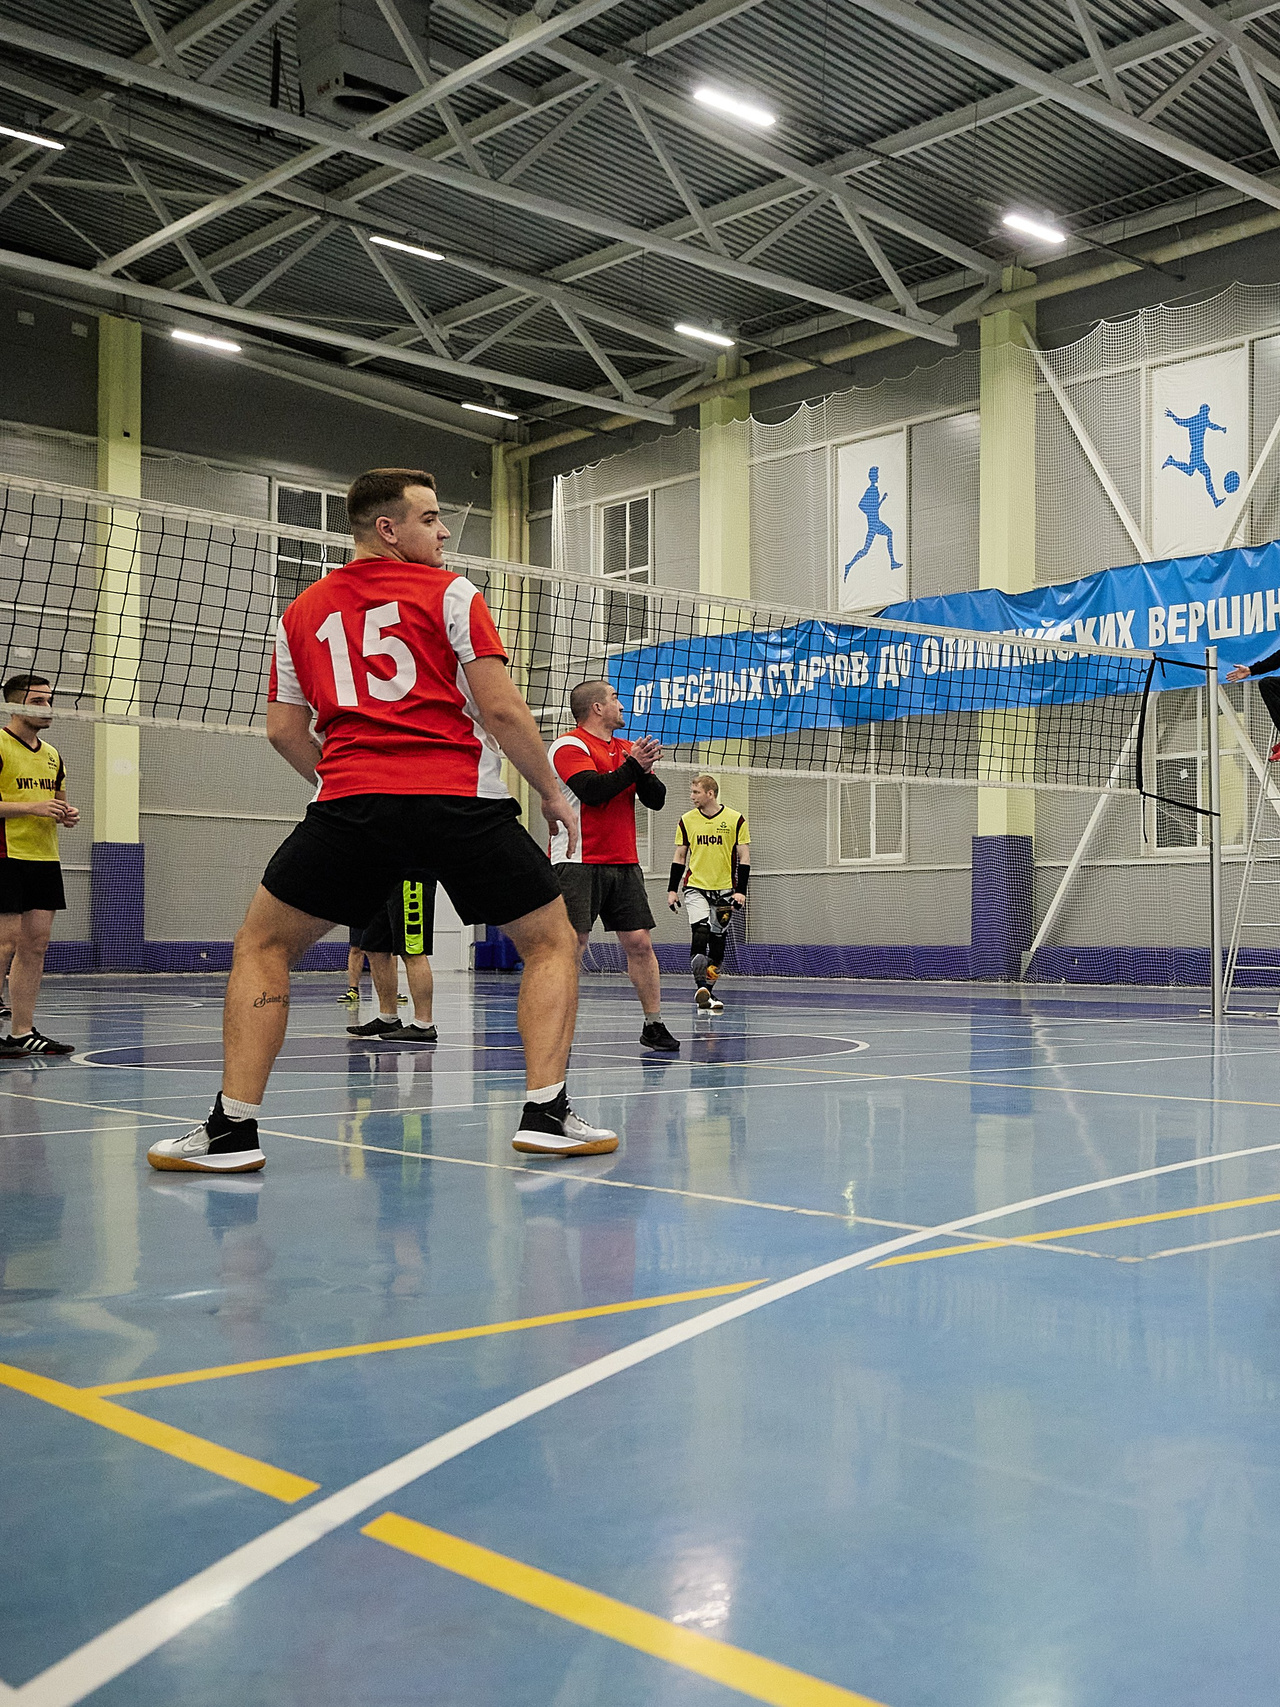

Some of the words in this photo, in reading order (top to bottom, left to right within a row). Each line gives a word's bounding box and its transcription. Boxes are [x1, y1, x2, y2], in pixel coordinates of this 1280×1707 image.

[315, 601, 417, 707] 15
[633, 681, 655, 716] ОТ
[767, 651, 870, 699] СТАРТОВ
[877, 642, 912, 689] ДО
[697, 835, 723, 847] ИЦФА
[253, 991, 282, 1008] Saint
